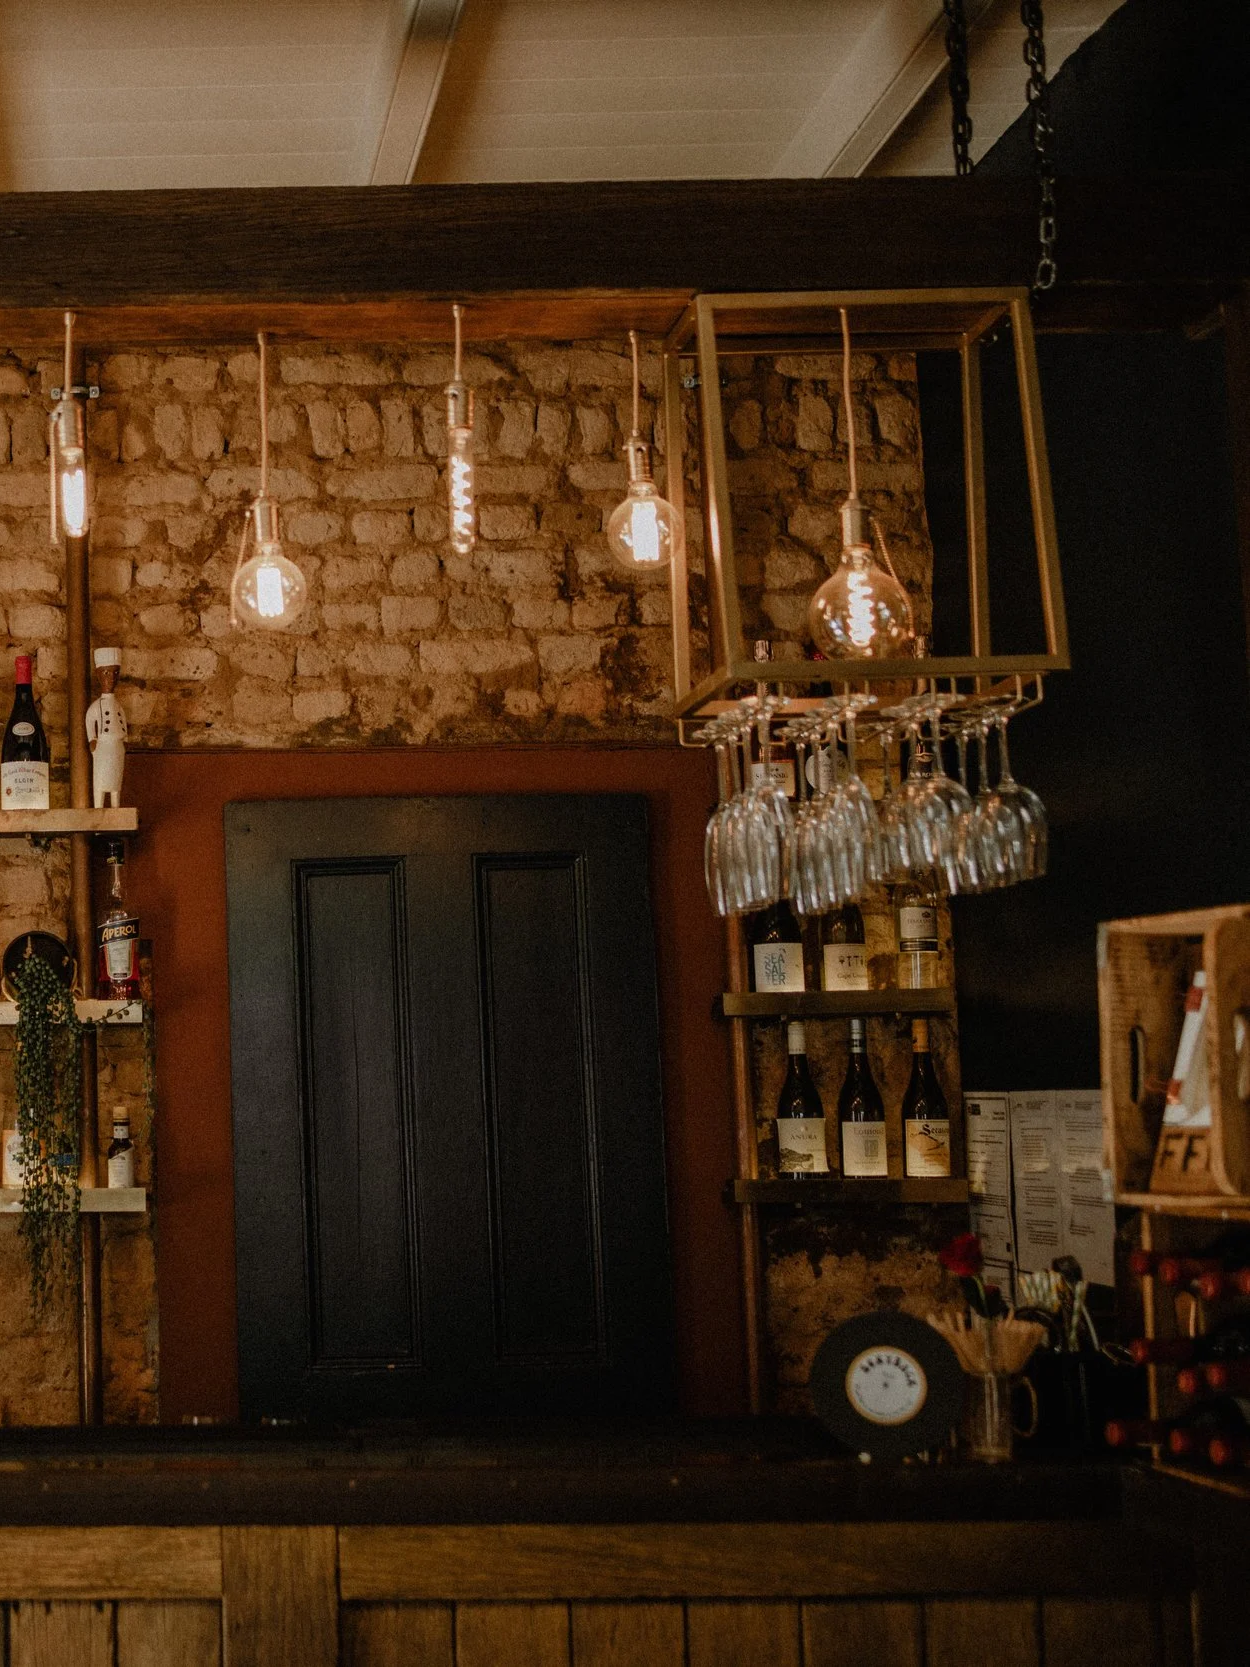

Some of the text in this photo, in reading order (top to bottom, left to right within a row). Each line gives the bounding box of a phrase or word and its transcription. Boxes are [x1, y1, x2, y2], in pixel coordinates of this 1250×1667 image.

[101, 925, 137, 942] APEROL
[764, 952, 785, 964] SEA
[764, 962, 785, 975] SAL
[764, 974, 786, 985] TER
